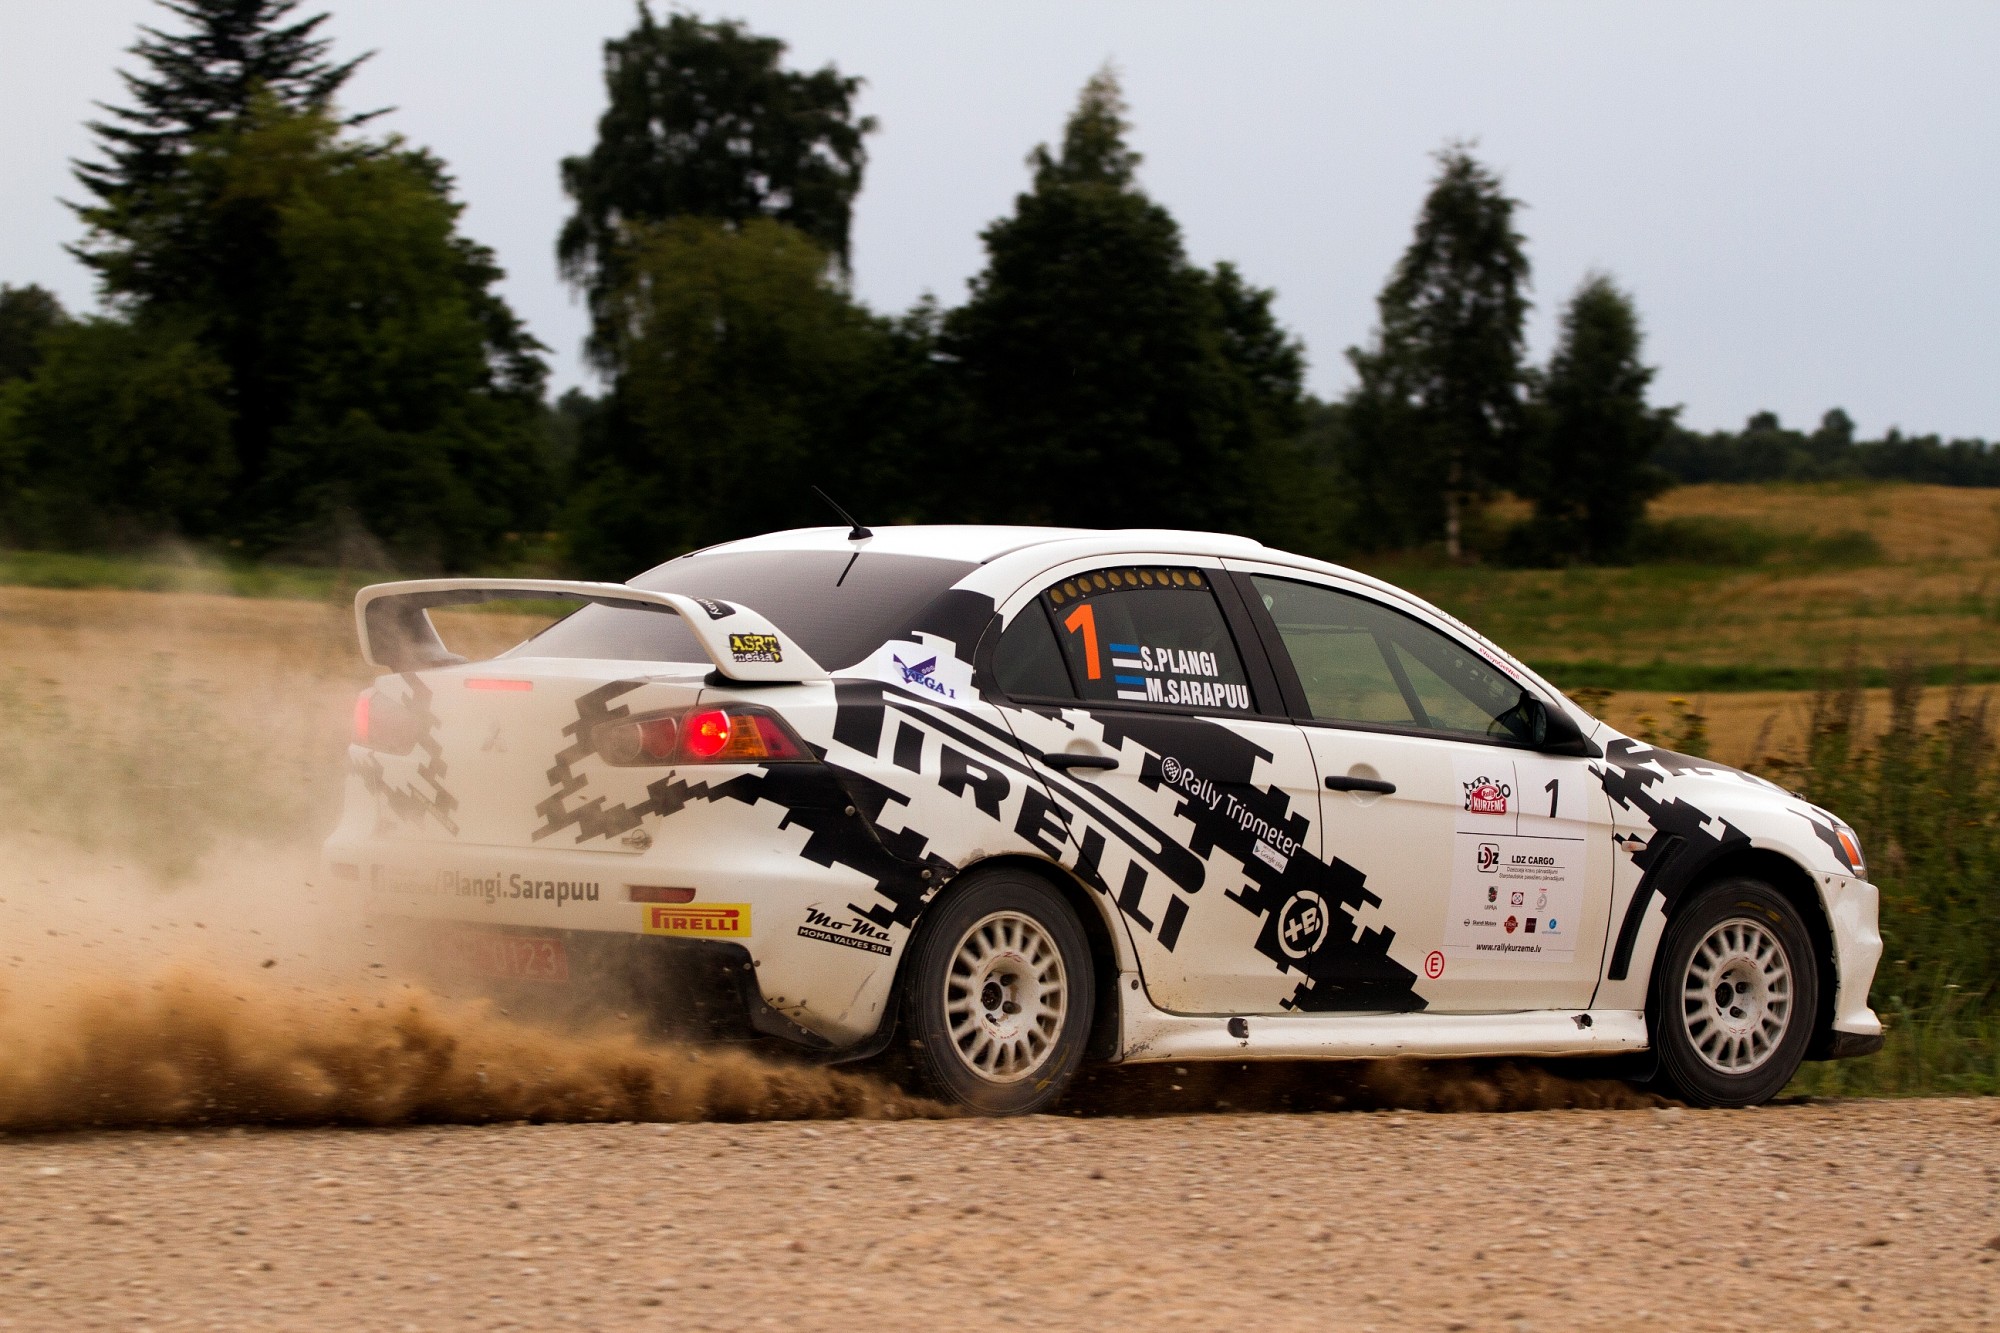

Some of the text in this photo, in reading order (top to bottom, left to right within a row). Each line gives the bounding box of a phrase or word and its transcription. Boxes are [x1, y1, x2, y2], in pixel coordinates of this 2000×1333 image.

[732, 635, 776, 651] ASRT
[1064, 603, 1101, 680] 1
[733, 650, 772, 662] media
[1140, 646, 1218, 677] S.PLANGI
[901, 668, 956, 700] VEGA 1
[1145, 677, 1249, 709] M.SARAPUU
[1473, 797, 1505, 812] KURZEME
[1544, 779, 1559, 818] 1
[830, 677, 1206, 954] PIRELLI
[1179, 768, 1302, 857] Rally Tripmeter
[1511, 855, 1555, 866] LDZ CARGO
[651, 907, 739, 931] PIRELLI
[800, 928, 890, 955] MOMA VALVES SRL
[1476, 943, 1542, 954] www.rallykurzeme.lv
[1430, 957, 1440, 972] E
